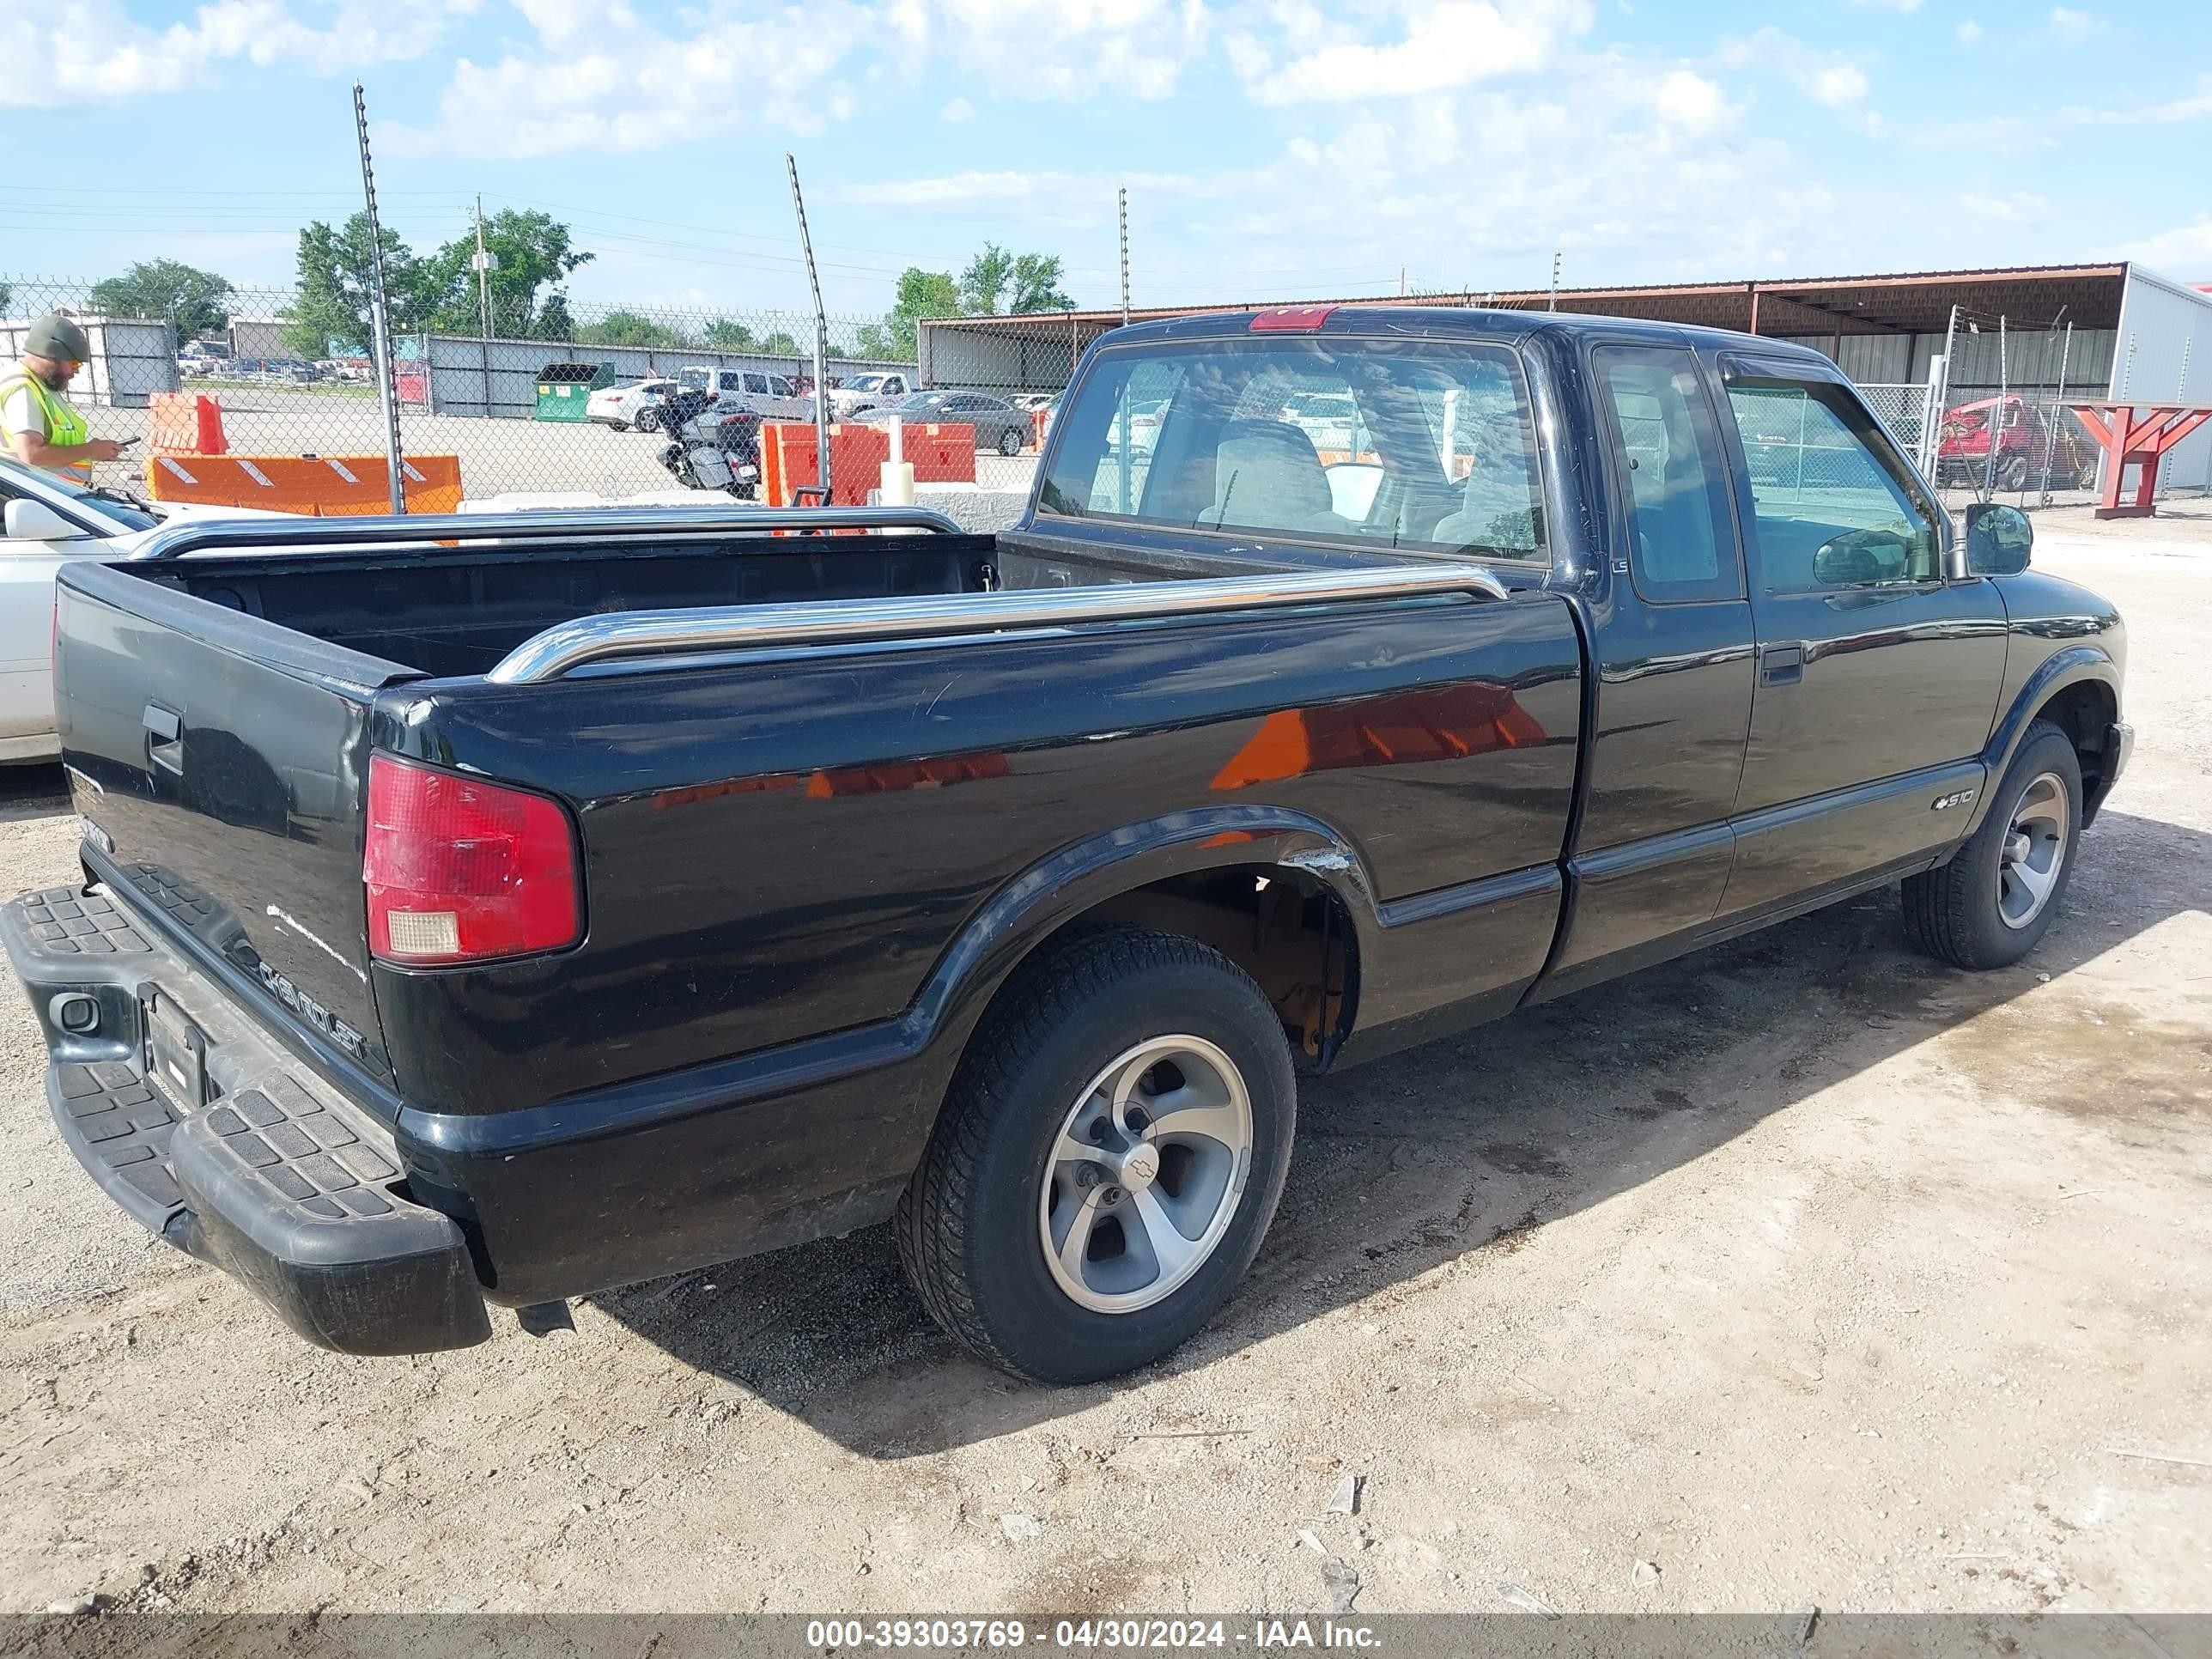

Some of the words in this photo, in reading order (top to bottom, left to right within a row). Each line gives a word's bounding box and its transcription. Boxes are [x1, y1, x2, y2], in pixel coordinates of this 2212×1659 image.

[1612, 561, 1628, 574] LS
[1947, 789, 1974, 808] S10
[259, 961, 365, 1060] CHEVROLET
